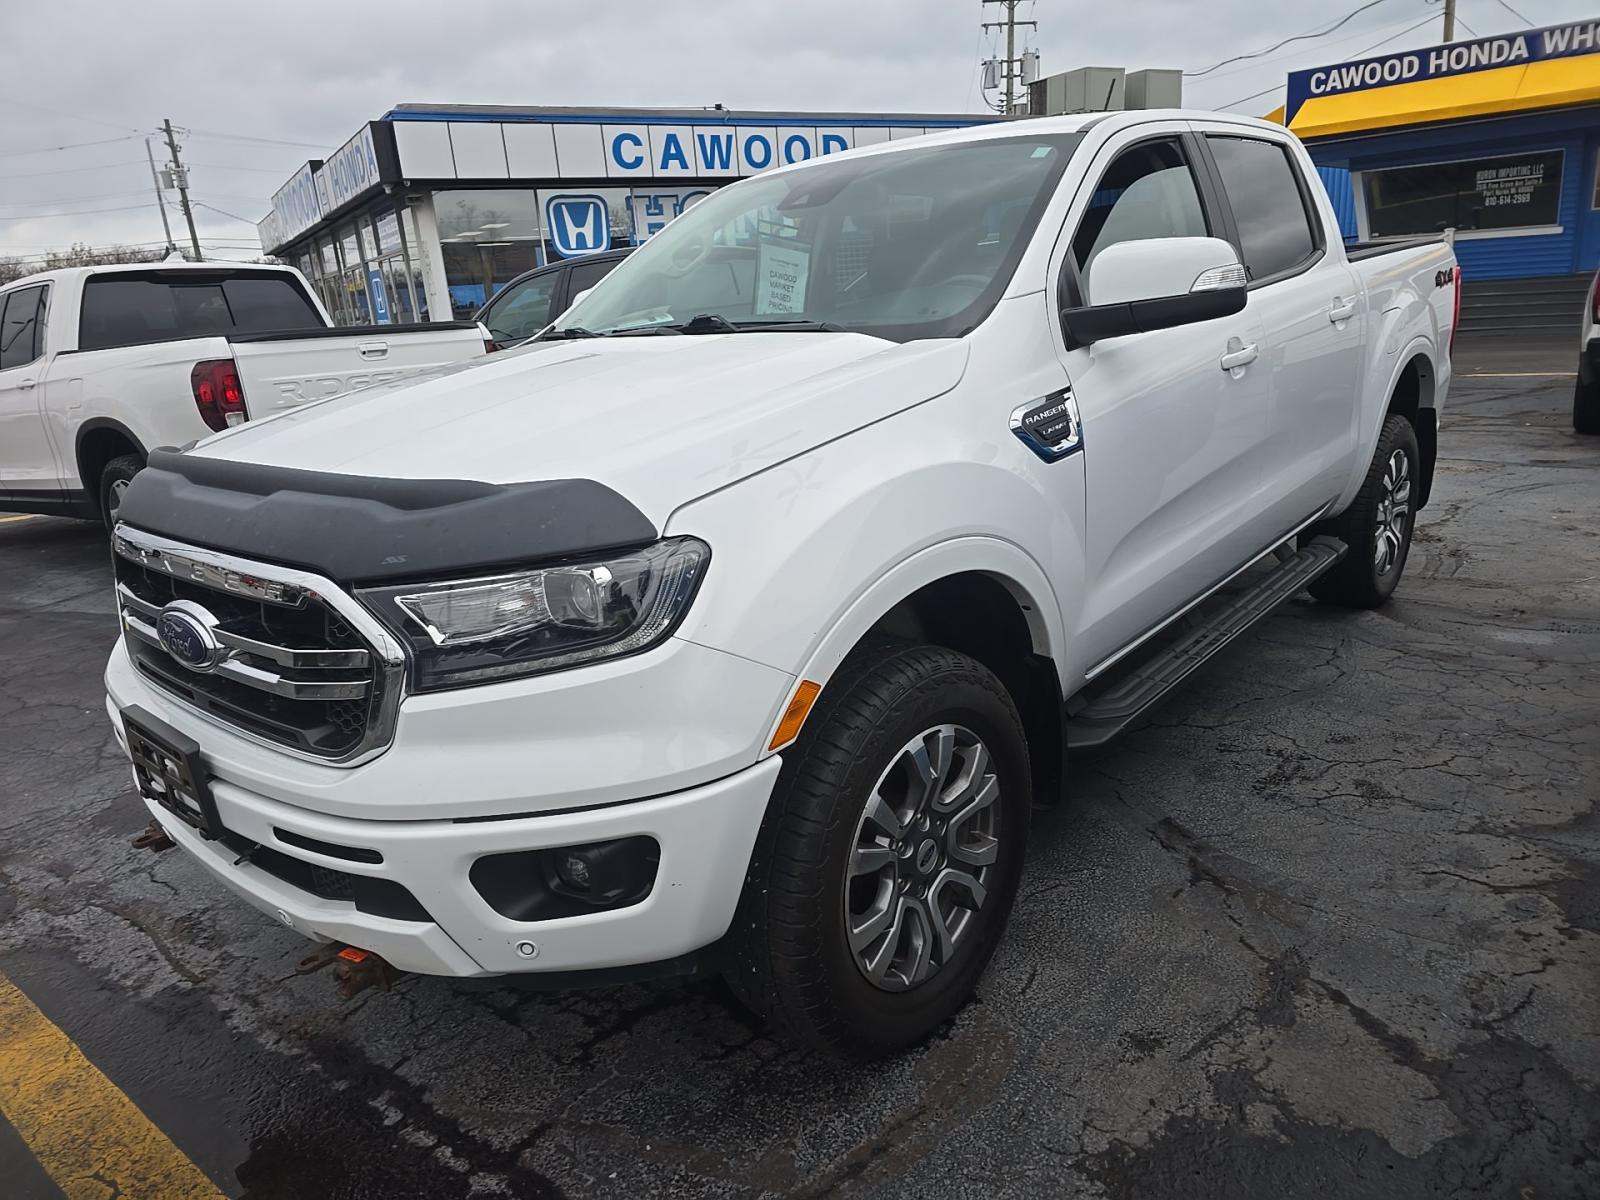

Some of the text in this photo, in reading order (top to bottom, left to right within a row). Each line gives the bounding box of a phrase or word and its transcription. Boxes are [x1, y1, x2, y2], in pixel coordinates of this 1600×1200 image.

[1310, 23, 1600, 94] CAWOOD HONDA WH
[330, 135, 377, 198] HONDA
[1498, 164, 1531, 178] IMPORTING
[1533, 163, 1545, 175] LLC
[769, 270, 797, 283] CAWOOD
[769, 280, 794, 293] MARKET
[273, 370, 404, 403] RIDGE
[1025, 403, 1066, 425] RANGER
[162, 621, 194, 658] Ford
